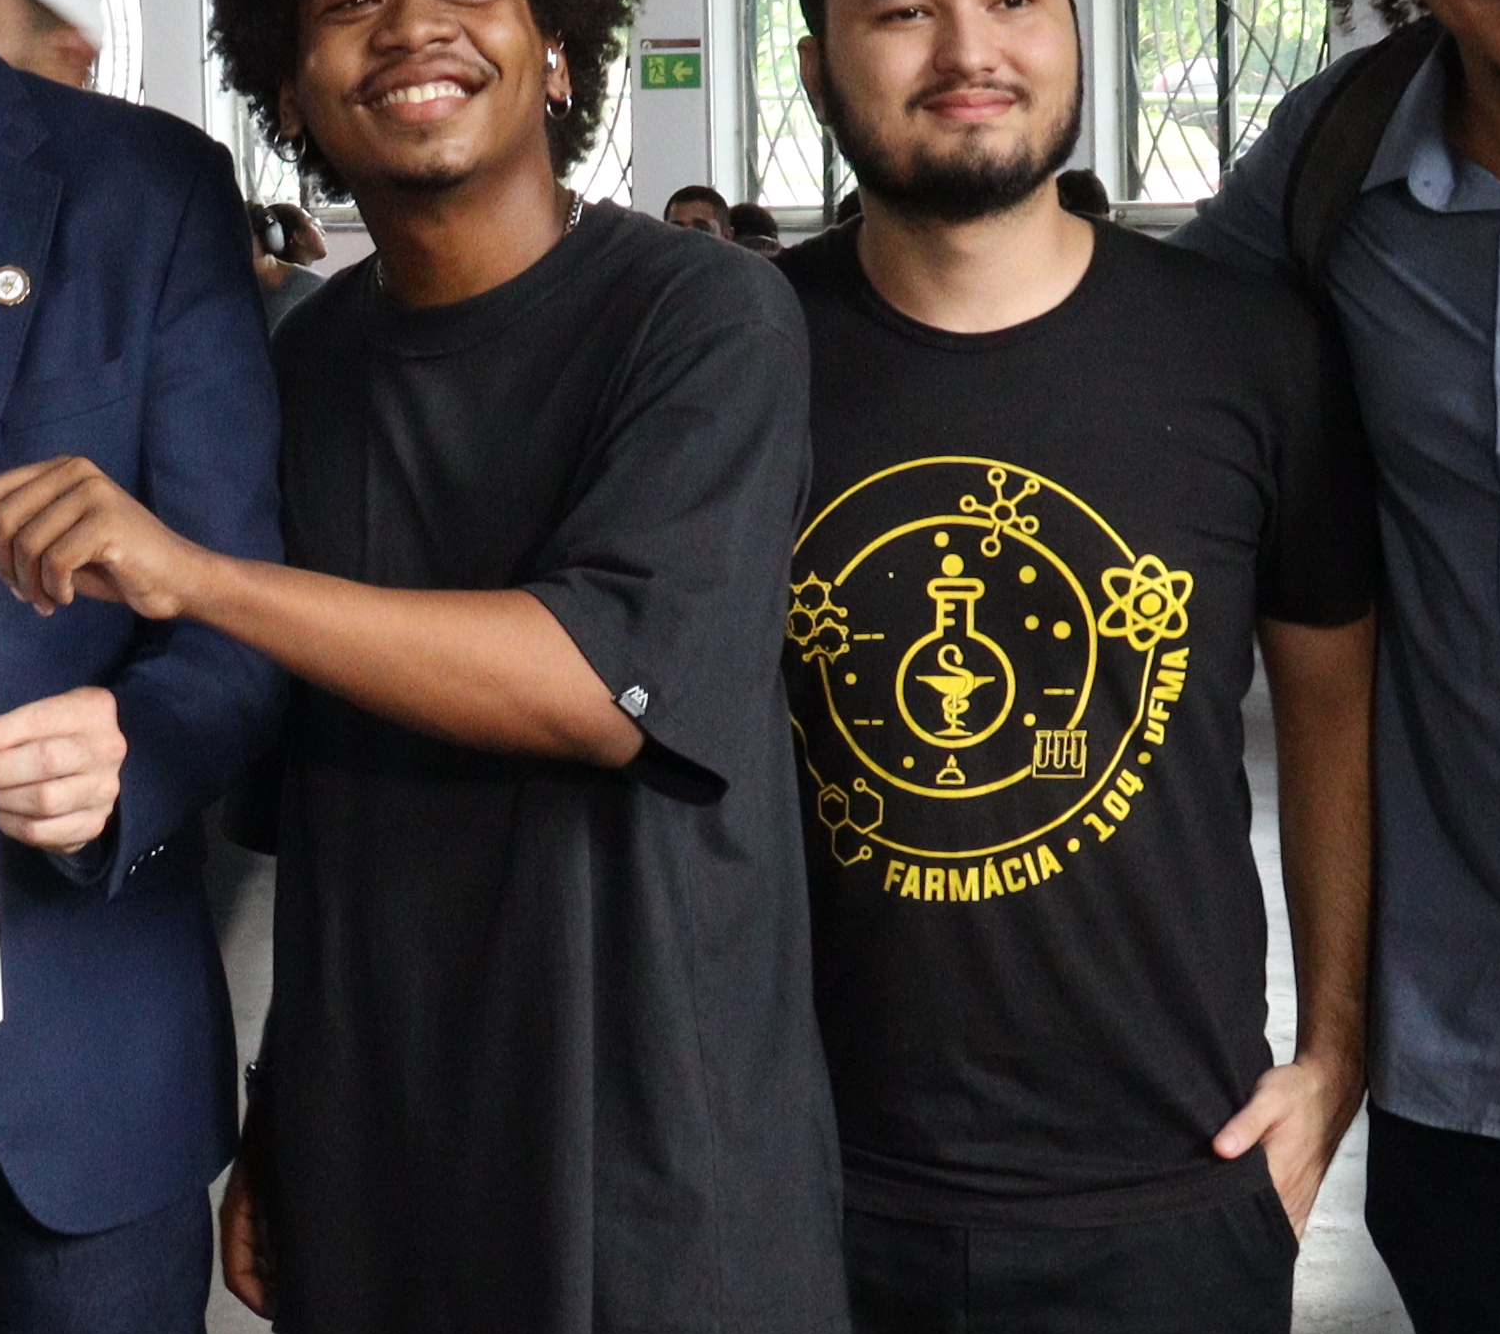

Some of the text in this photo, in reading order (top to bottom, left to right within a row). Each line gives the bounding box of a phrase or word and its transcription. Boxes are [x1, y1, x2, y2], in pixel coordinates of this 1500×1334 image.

[883, 647, 1190, 902] FARMÁCIA 104 UFMA
